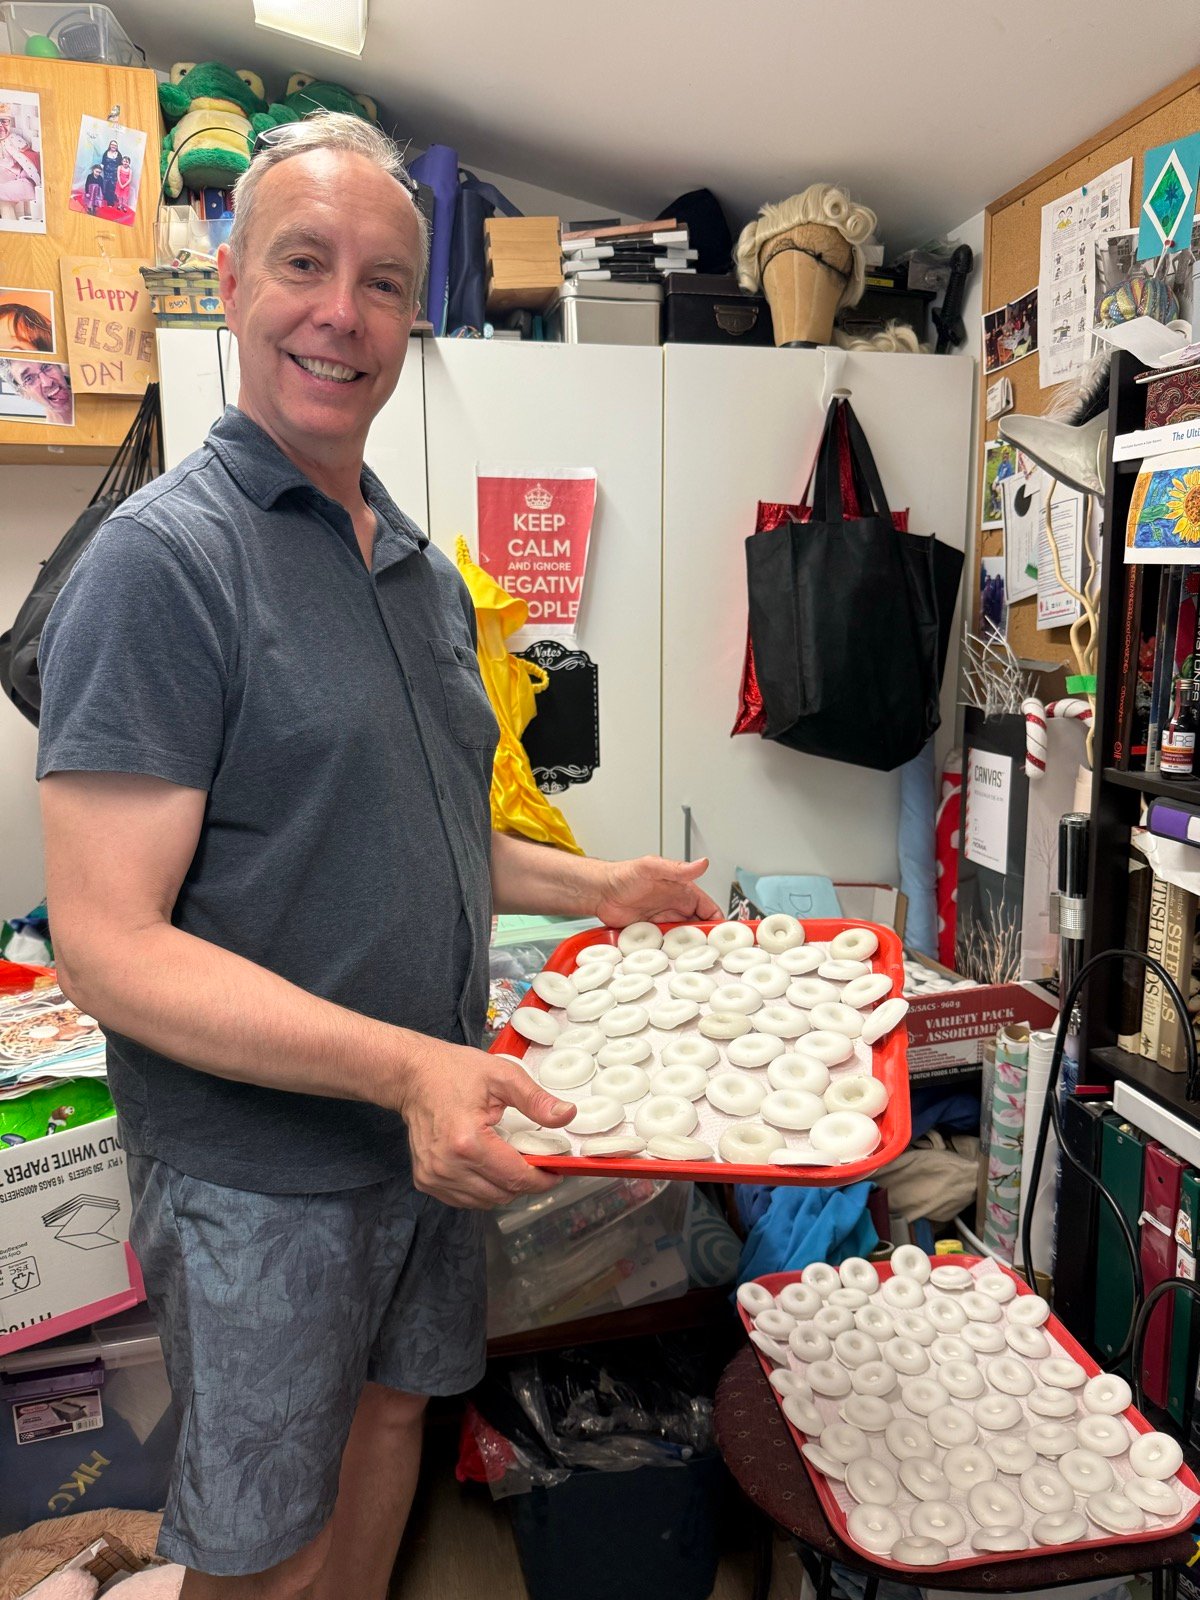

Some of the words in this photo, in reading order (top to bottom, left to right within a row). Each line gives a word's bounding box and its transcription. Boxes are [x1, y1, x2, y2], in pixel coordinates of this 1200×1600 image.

[76, 277, 139, 312] Happy
[75, 317, 155, 363] ELSIE
[81, 361, 124, 386] DAY
[1172, 431, 1185, 441] The
[1186, 427, 1200, 440] Ulti
[514, 514, 565, 532] KEEP
[508, 539, 571, 557] CALM
[508, 562, 531, 571] AND
[533, 562, 571, 571] IGNORE
[527, 601, 578, 618] OPLE
[531, 646, 563, 658] Notes
[974, 765, 1003, 788] CANVAS
[1150, 874, 1168, 932] ITISH
[1161, 922, 1183, 1023] SHELS
[925, 1012, 978, 1029] VARIETY
[982, 1008, 1015, 1021] PACK
[99, 1136, 121, 1154] LD
[51, 1142, 97, 1169] WHITE
[118, 1156, 124, 1165] 1
[3, 1157, 50, 1184] PAPER
[68, 1165, 93, 1181] SHEETS
[93, 1163, 104, 1173] 250
[107, 1160, 119, 1170] PLY
[39, 1177, 58, 1191] BAGS
[58, 1175, 65, 1184] 16
[9, 1264, 29, 1276] FSC
